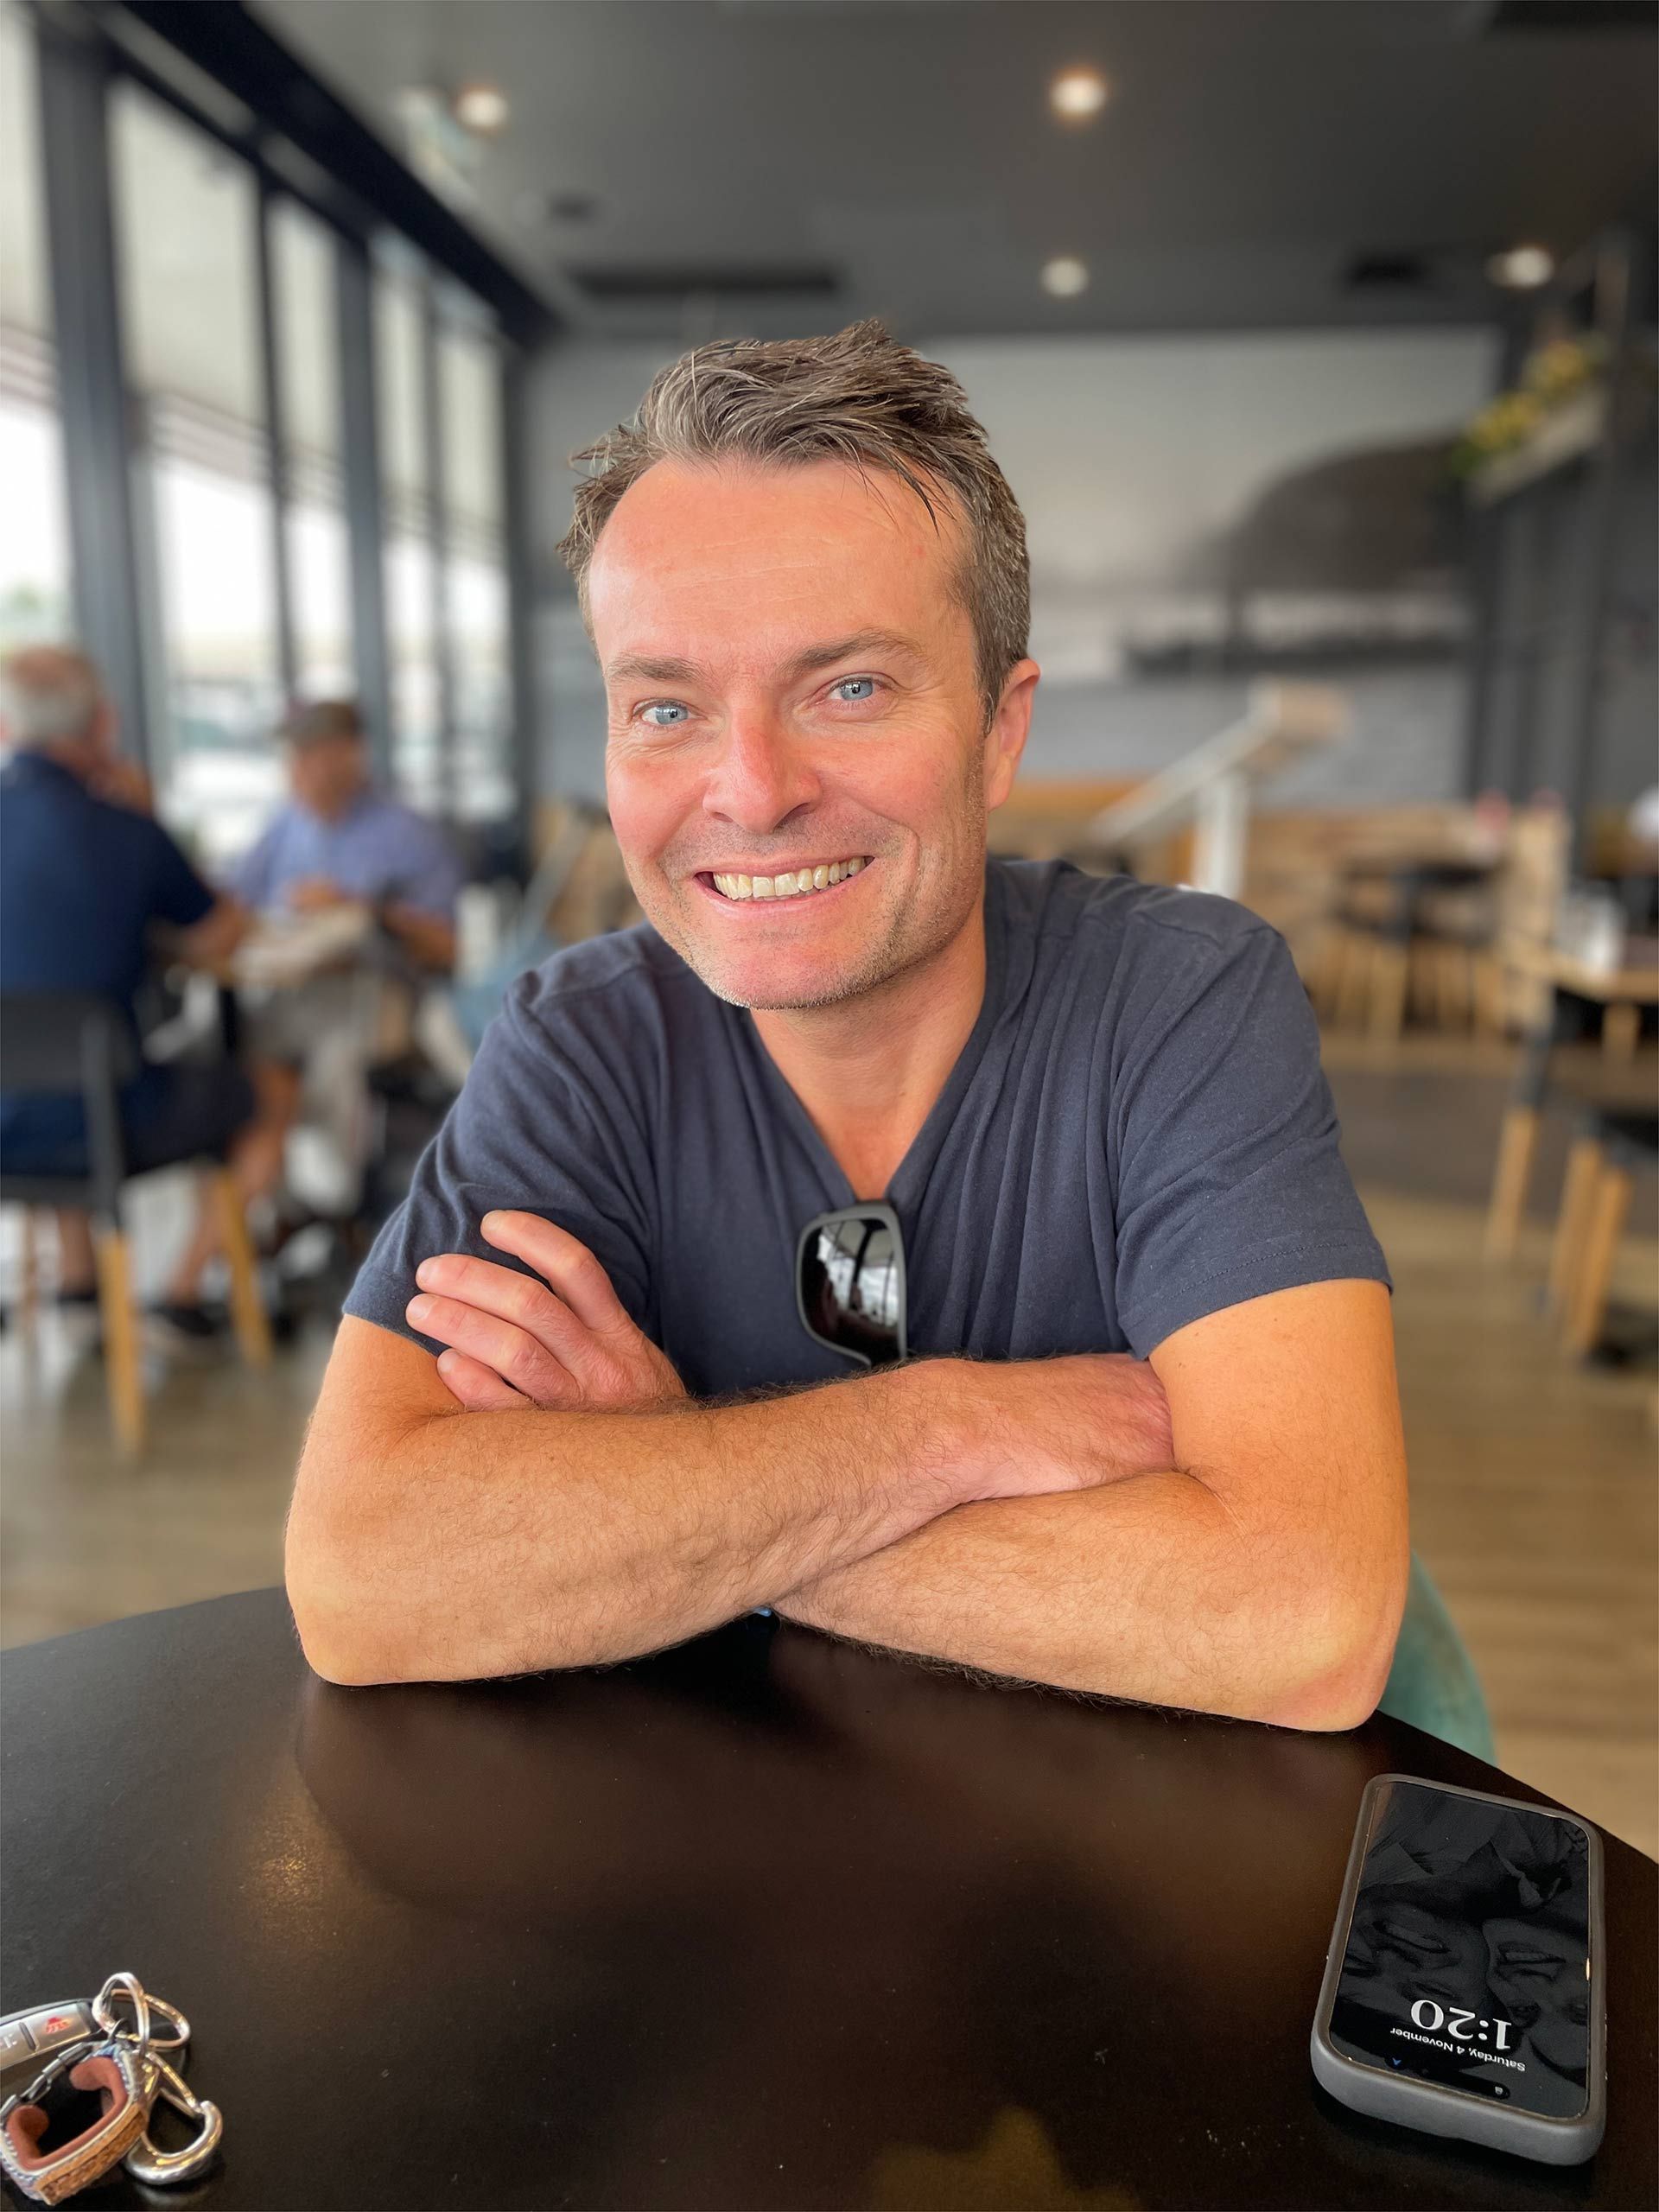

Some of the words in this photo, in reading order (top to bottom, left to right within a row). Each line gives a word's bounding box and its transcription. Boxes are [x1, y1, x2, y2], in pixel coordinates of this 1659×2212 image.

[1411, 1999, 1512, 2050] 1:20
[1390, 2028, 1453, 2051] November
[1456, 2045, 1465, 2055] 4
[1468, 2048, 1526, 2072] Saturday,
